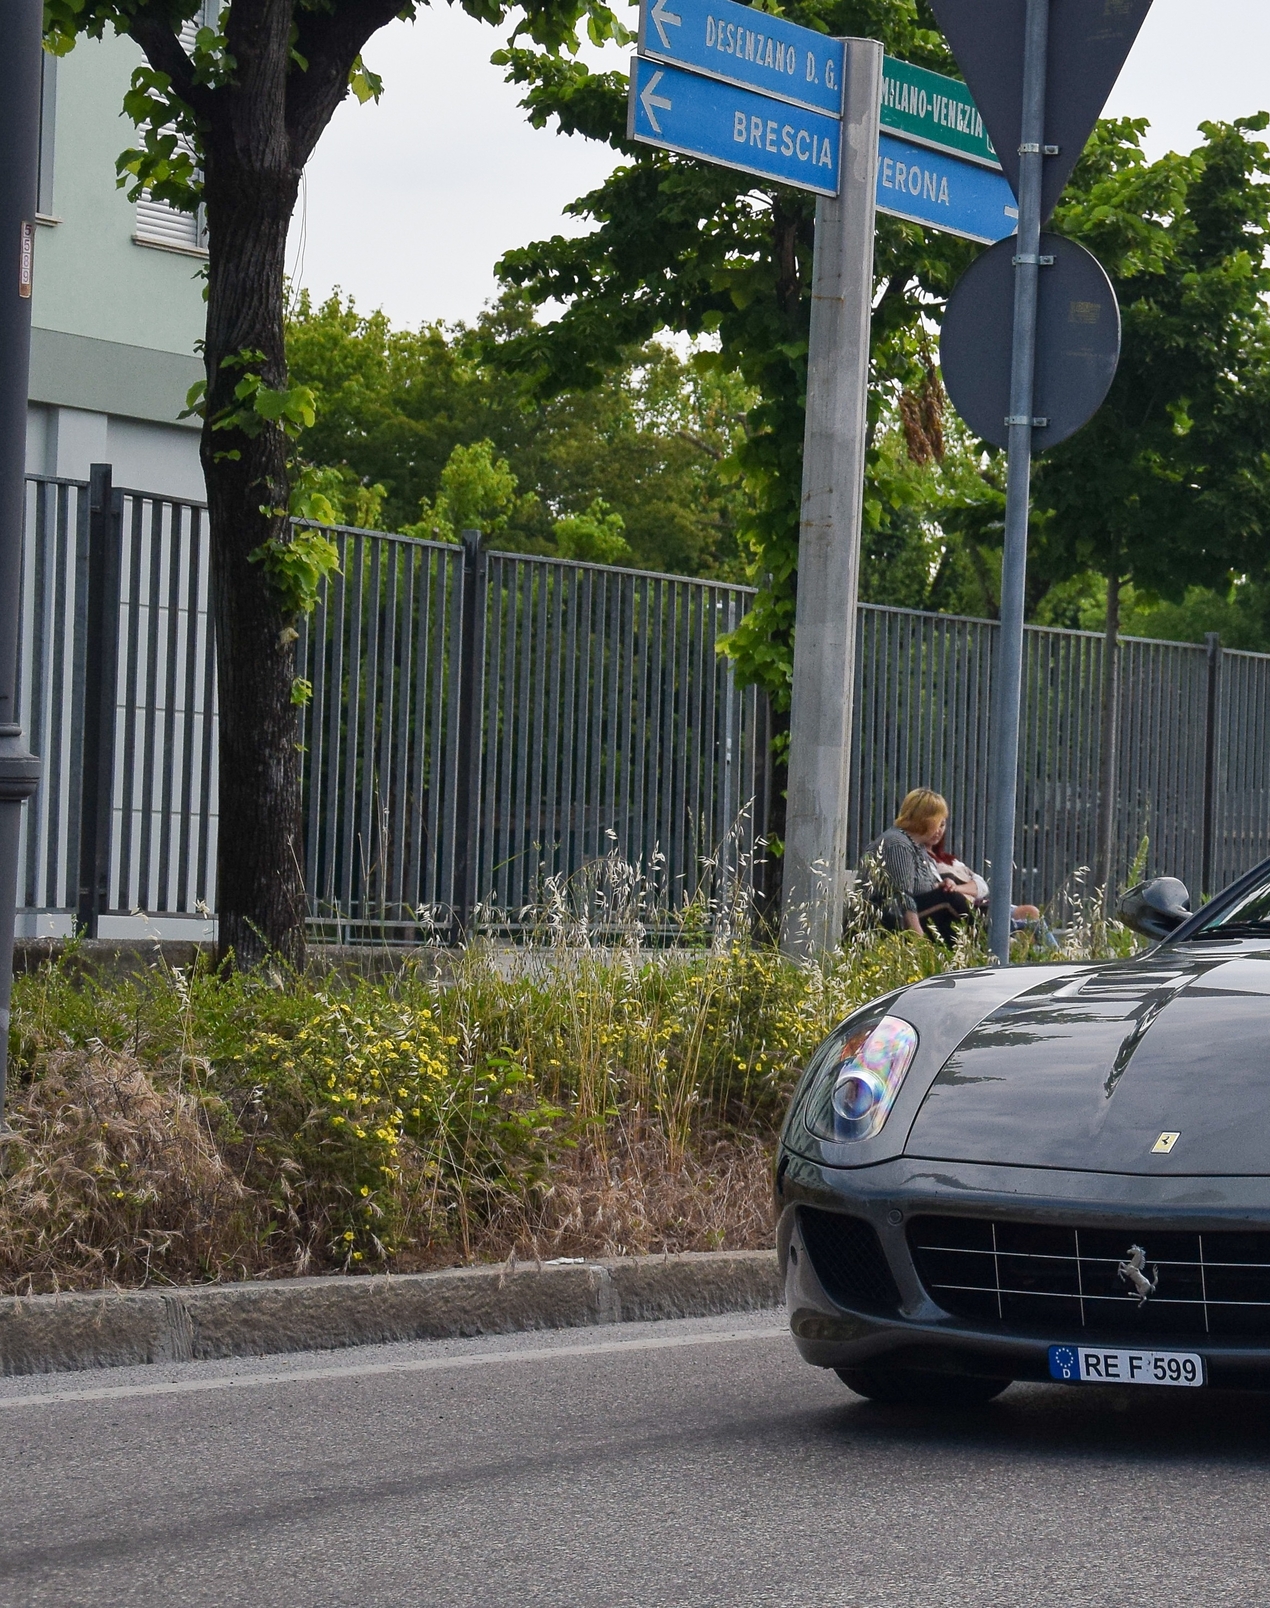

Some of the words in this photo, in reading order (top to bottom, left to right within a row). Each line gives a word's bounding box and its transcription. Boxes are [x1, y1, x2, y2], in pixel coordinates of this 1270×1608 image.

[705, 15, 796, 75] DESENZANO
[806, 51, 819, 84] D.
[825, 59, 838, 90] G.
[733, 110, 832, 169] BRESCIA
[1062, 1368, 1071, 1378] D
[1084, 1353, 1121, 1378] RE
[1129, 1356, 1143, 1379] F
[1153, 1357, 1197, 1382] 599
